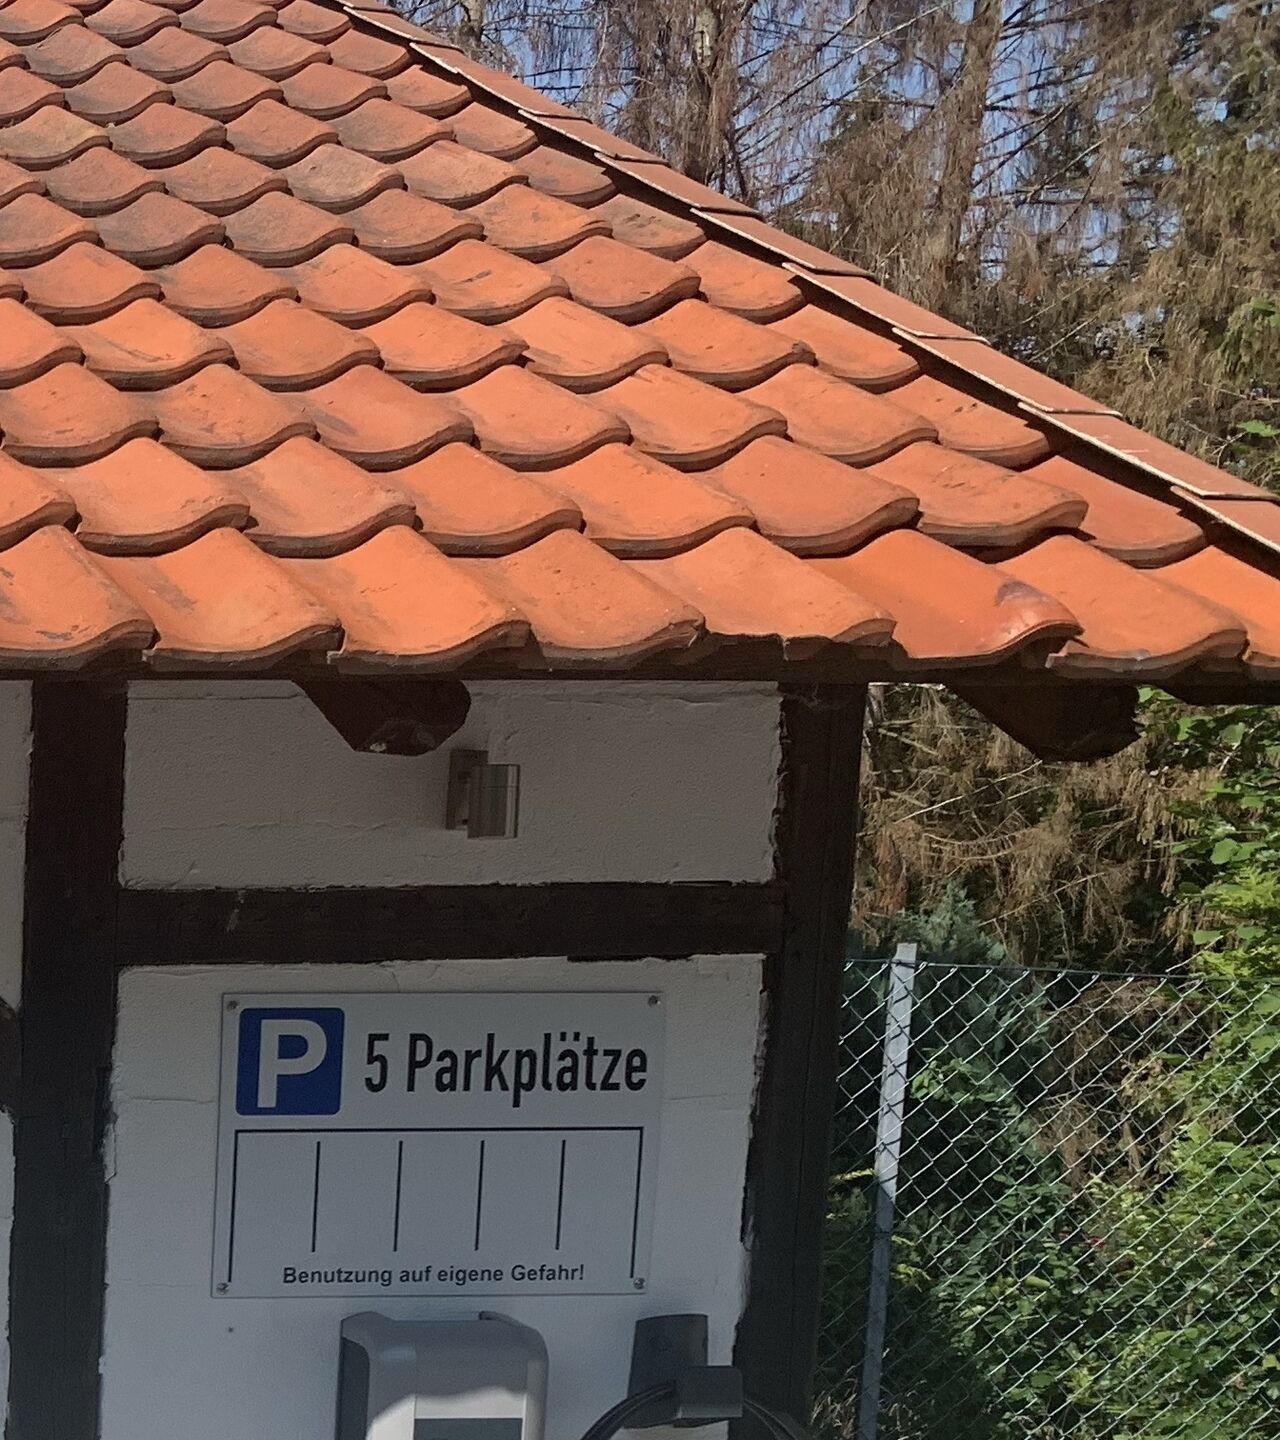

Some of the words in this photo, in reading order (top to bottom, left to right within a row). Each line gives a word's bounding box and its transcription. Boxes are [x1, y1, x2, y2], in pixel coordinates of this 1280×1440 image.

[256, 1018, 328, 1109] P
[363, 1031, 392, 1095] 5
[405, 1030, 649, 1110] Parkplätze
[281, 1265, 394, 1289] Benutzung
[398, 1264, 434, 1284] auf
[437, 1264, 505, 1288] eigene
[509, 1262, 586, 1283] Gefahr!
